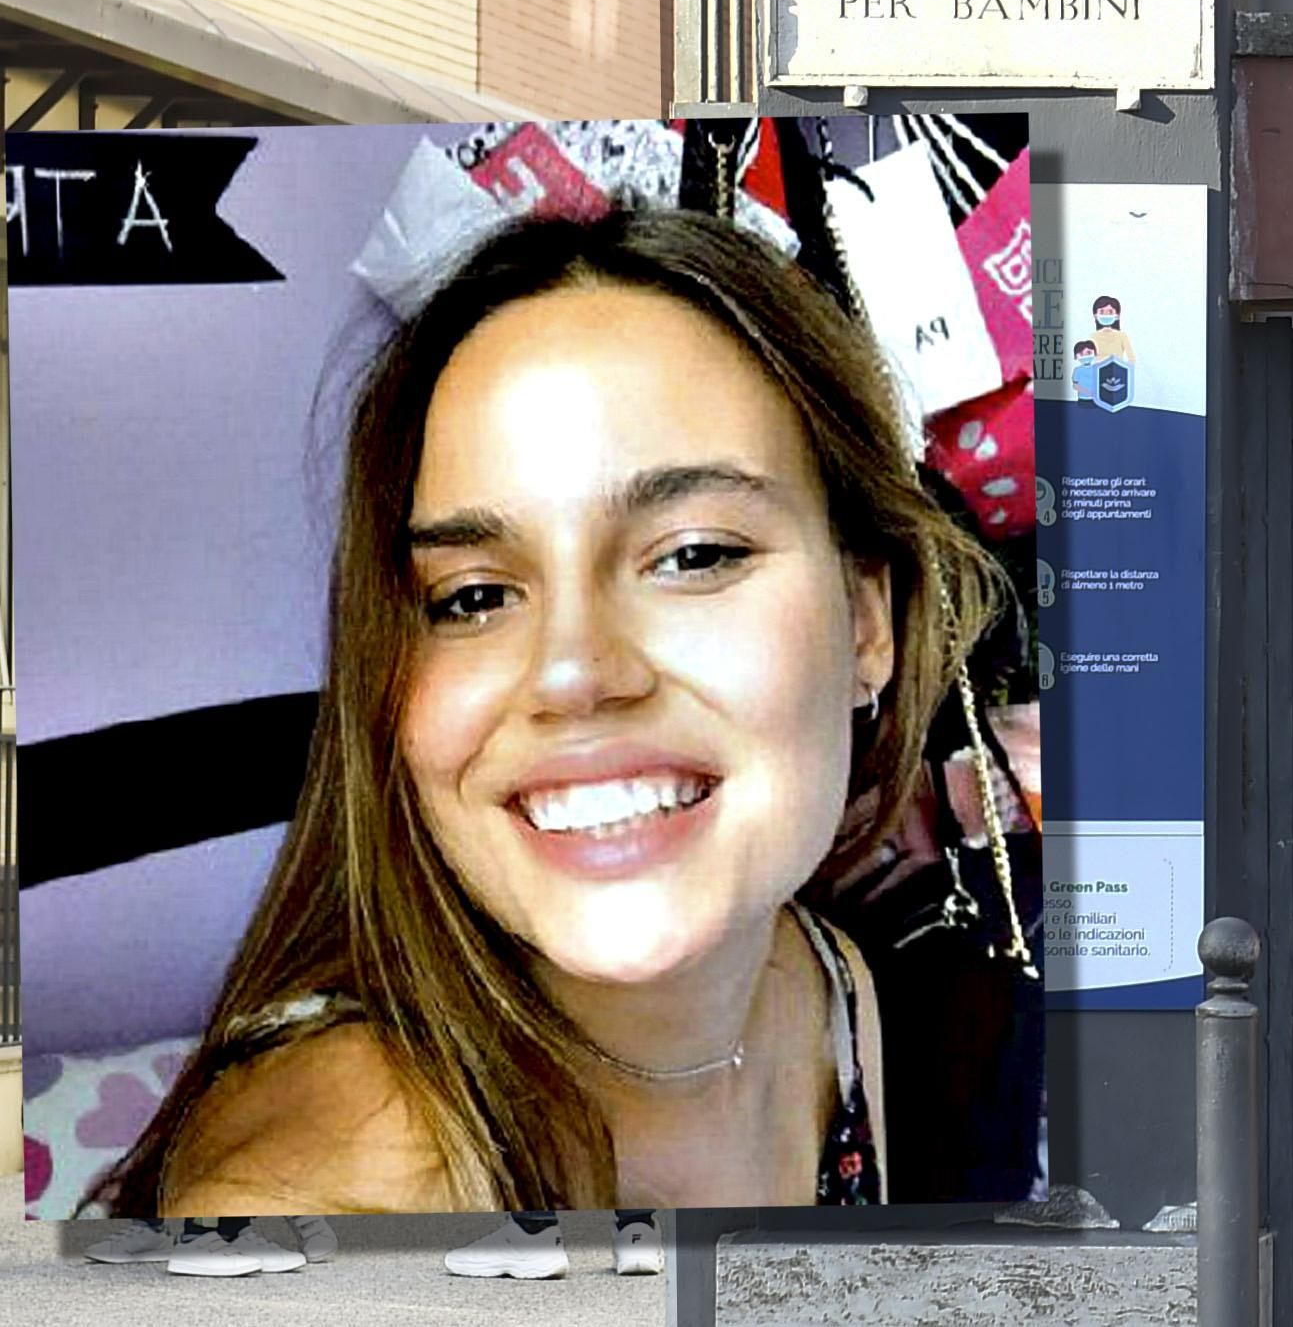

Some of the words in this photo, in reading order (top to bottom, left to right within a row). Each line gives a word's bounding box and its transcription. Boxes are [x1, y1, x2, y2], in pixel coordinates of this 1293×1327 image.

[1050, 881, 1093, 892] Green
[1096, 881, 1128, 892] Pass
[1064, 913, 1116, 924] familiari
[1059, 929, 1071, 940] le
[1075, 929, 1144, 940] indicazioni
